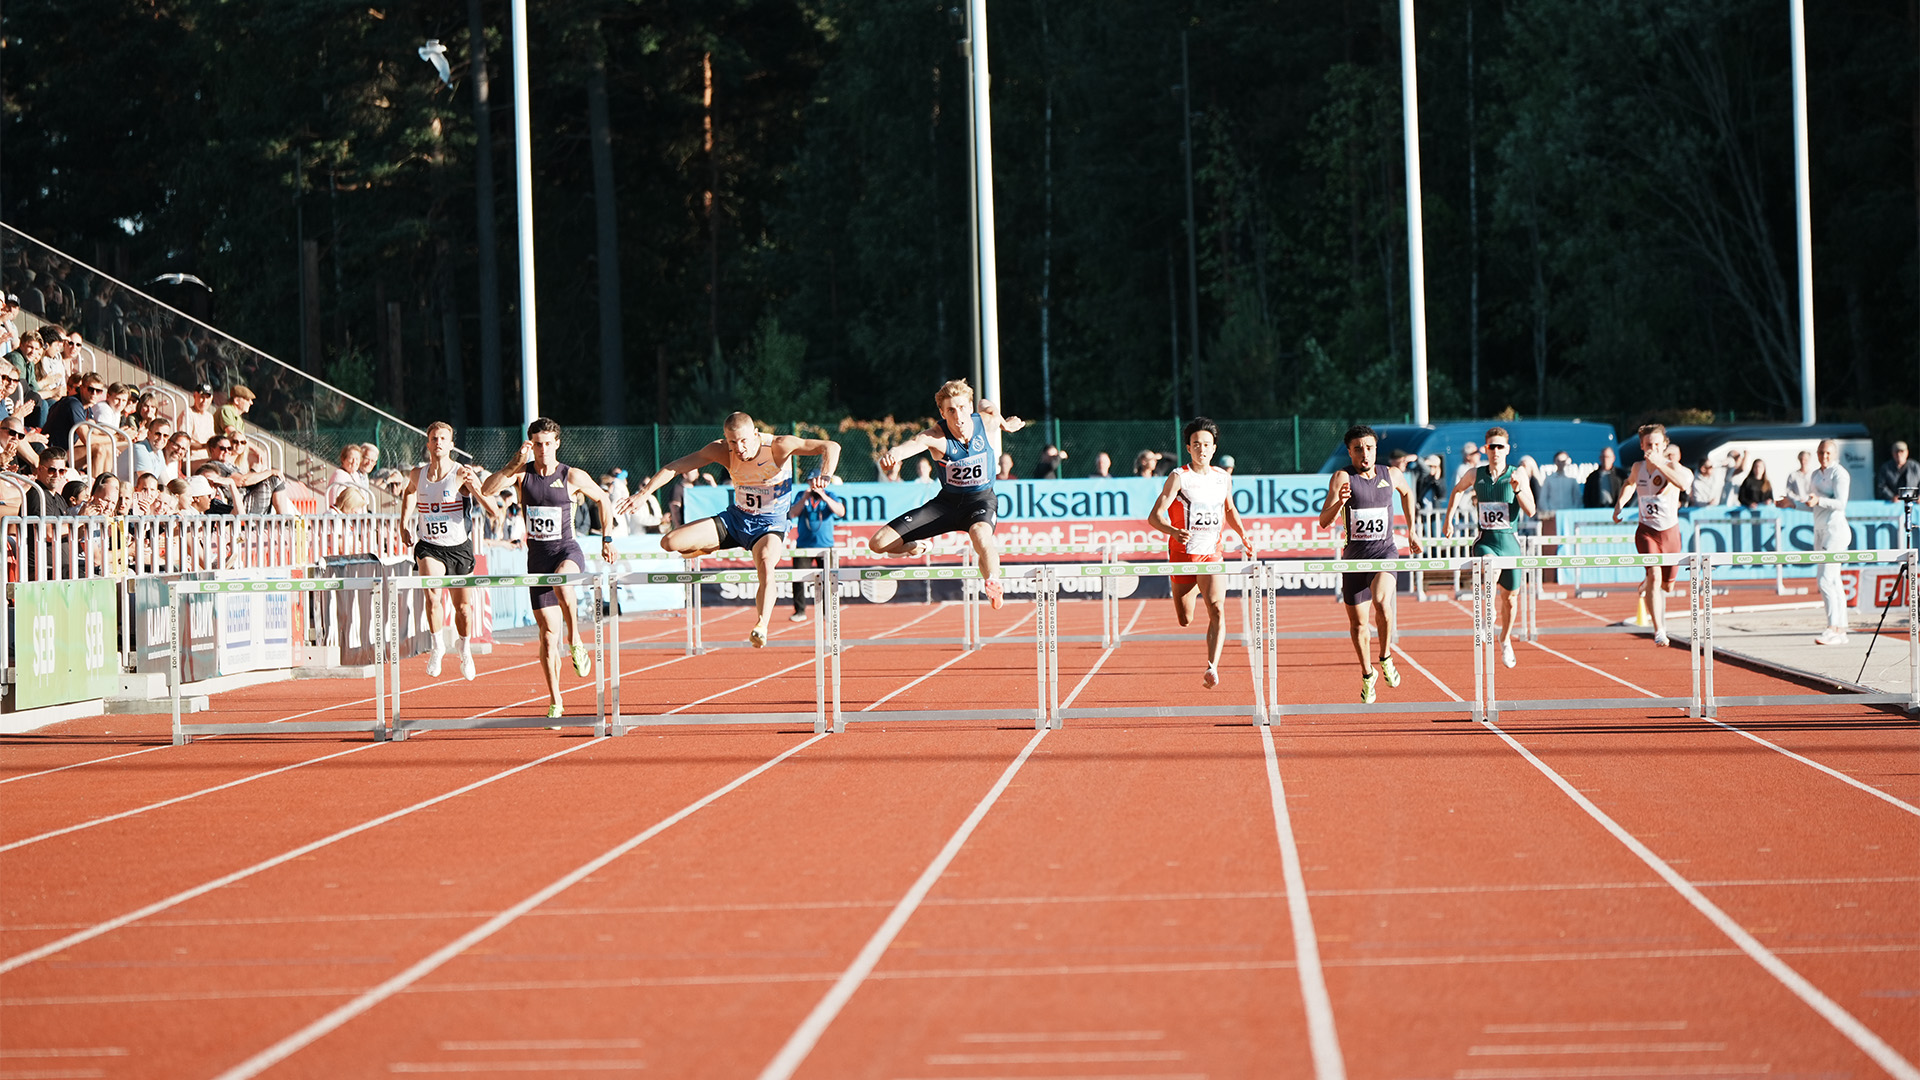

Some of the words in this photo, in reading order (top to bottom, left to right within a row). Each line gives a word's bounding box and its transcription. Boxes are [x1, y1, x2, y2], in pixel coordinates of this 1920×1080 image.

[951, 465, 982, 480] 226
[745, 493, 762, 508] 51
[996, 483, 1130, 518] olksam
[1232, 479, 1329, 515] olksa
[1483, 511, 1504, 523] 162
[1646, 503, 1659, 515] 31
[530, 517, 555, 533] 130
[1195, 512, 1219, 526] 253
[1355, 518, 1384, 534] 243
[426, 521, 448, 535] 155
[1682, 509, 1919, 566] olksm
[33, 614, 56, 678] SEB
[85, 610, 105, 672] SEB
